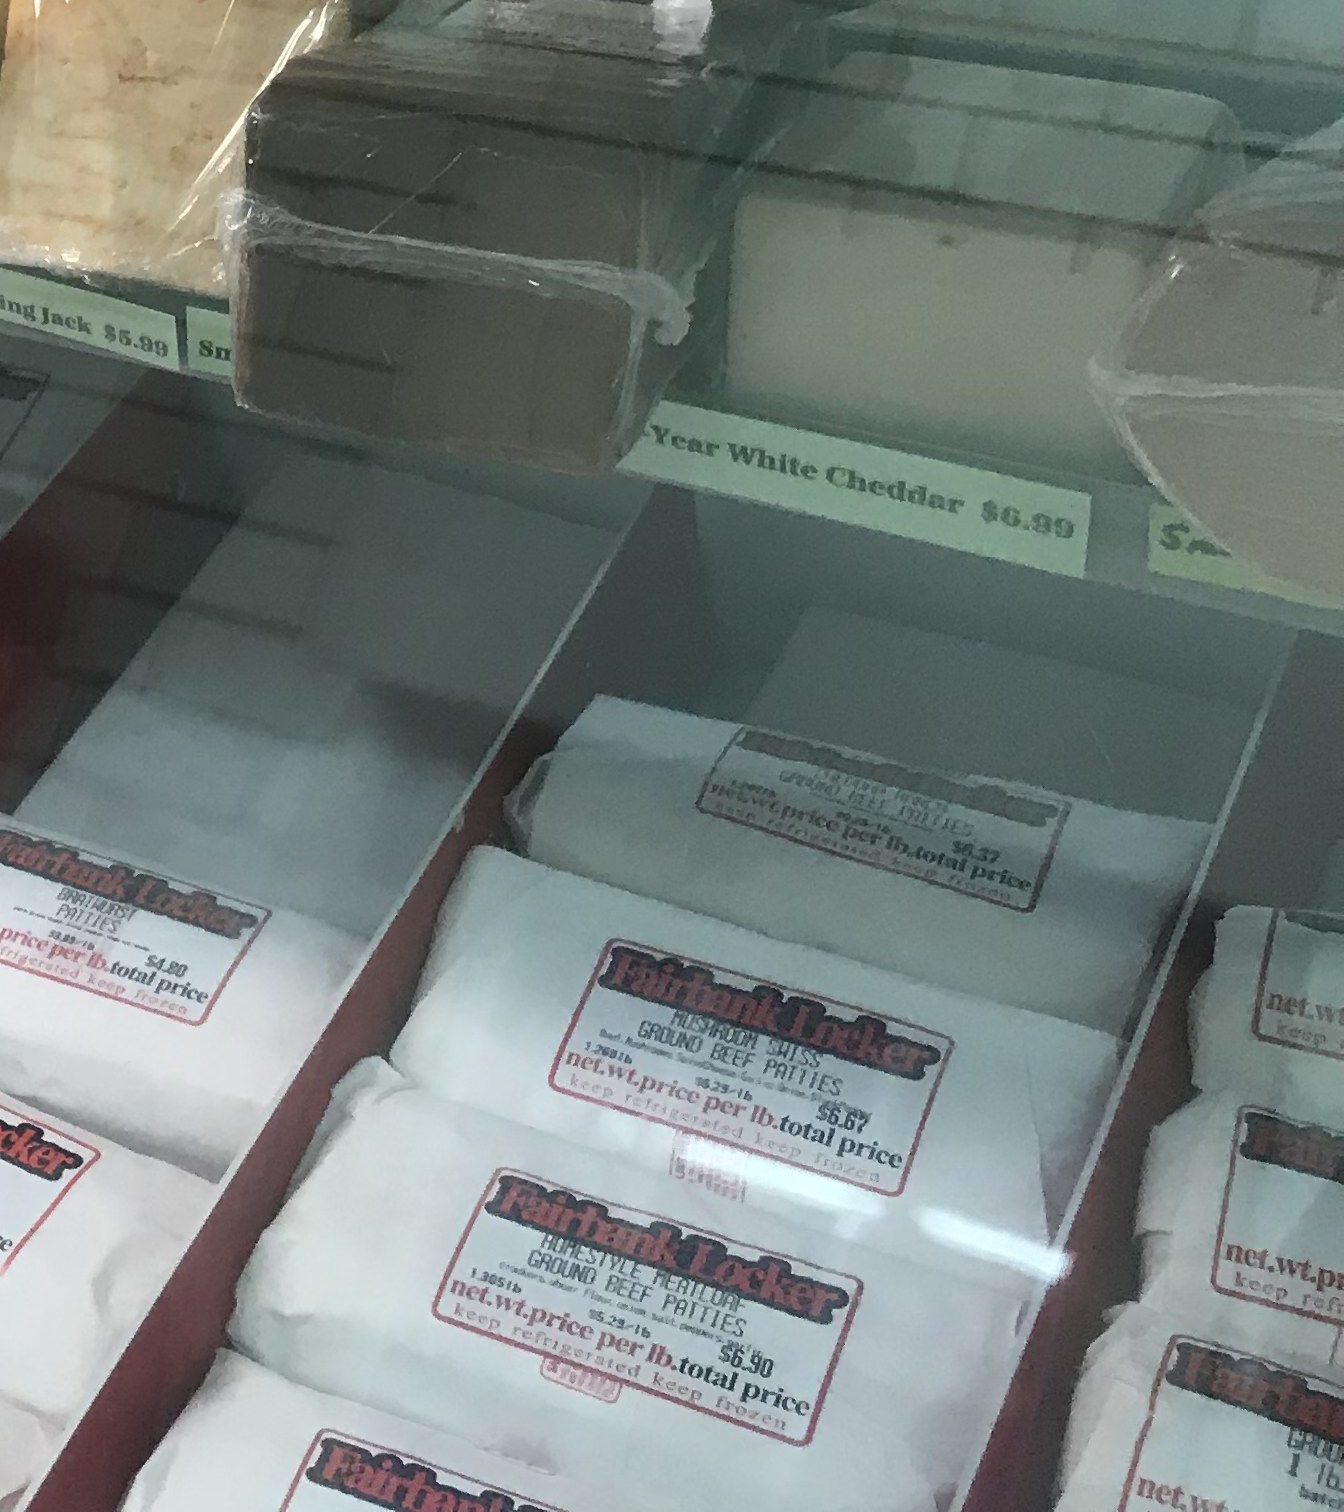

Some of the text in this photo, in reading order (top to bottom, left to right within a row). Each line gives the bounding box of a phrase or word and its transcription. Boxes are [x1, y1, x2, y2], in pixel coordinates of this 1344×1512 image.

[41, 305, 93, 337] Jack
[102, 323, 169, 358] $5.99
[728, 442, 1075, 540] White Cheddar $6.99
[56, 888, 137, 920] BRATWURST
[56, 904, 123, 932] PATTIES
[527, 1250, 748, 1337] GROUND BEEF PATTIES
